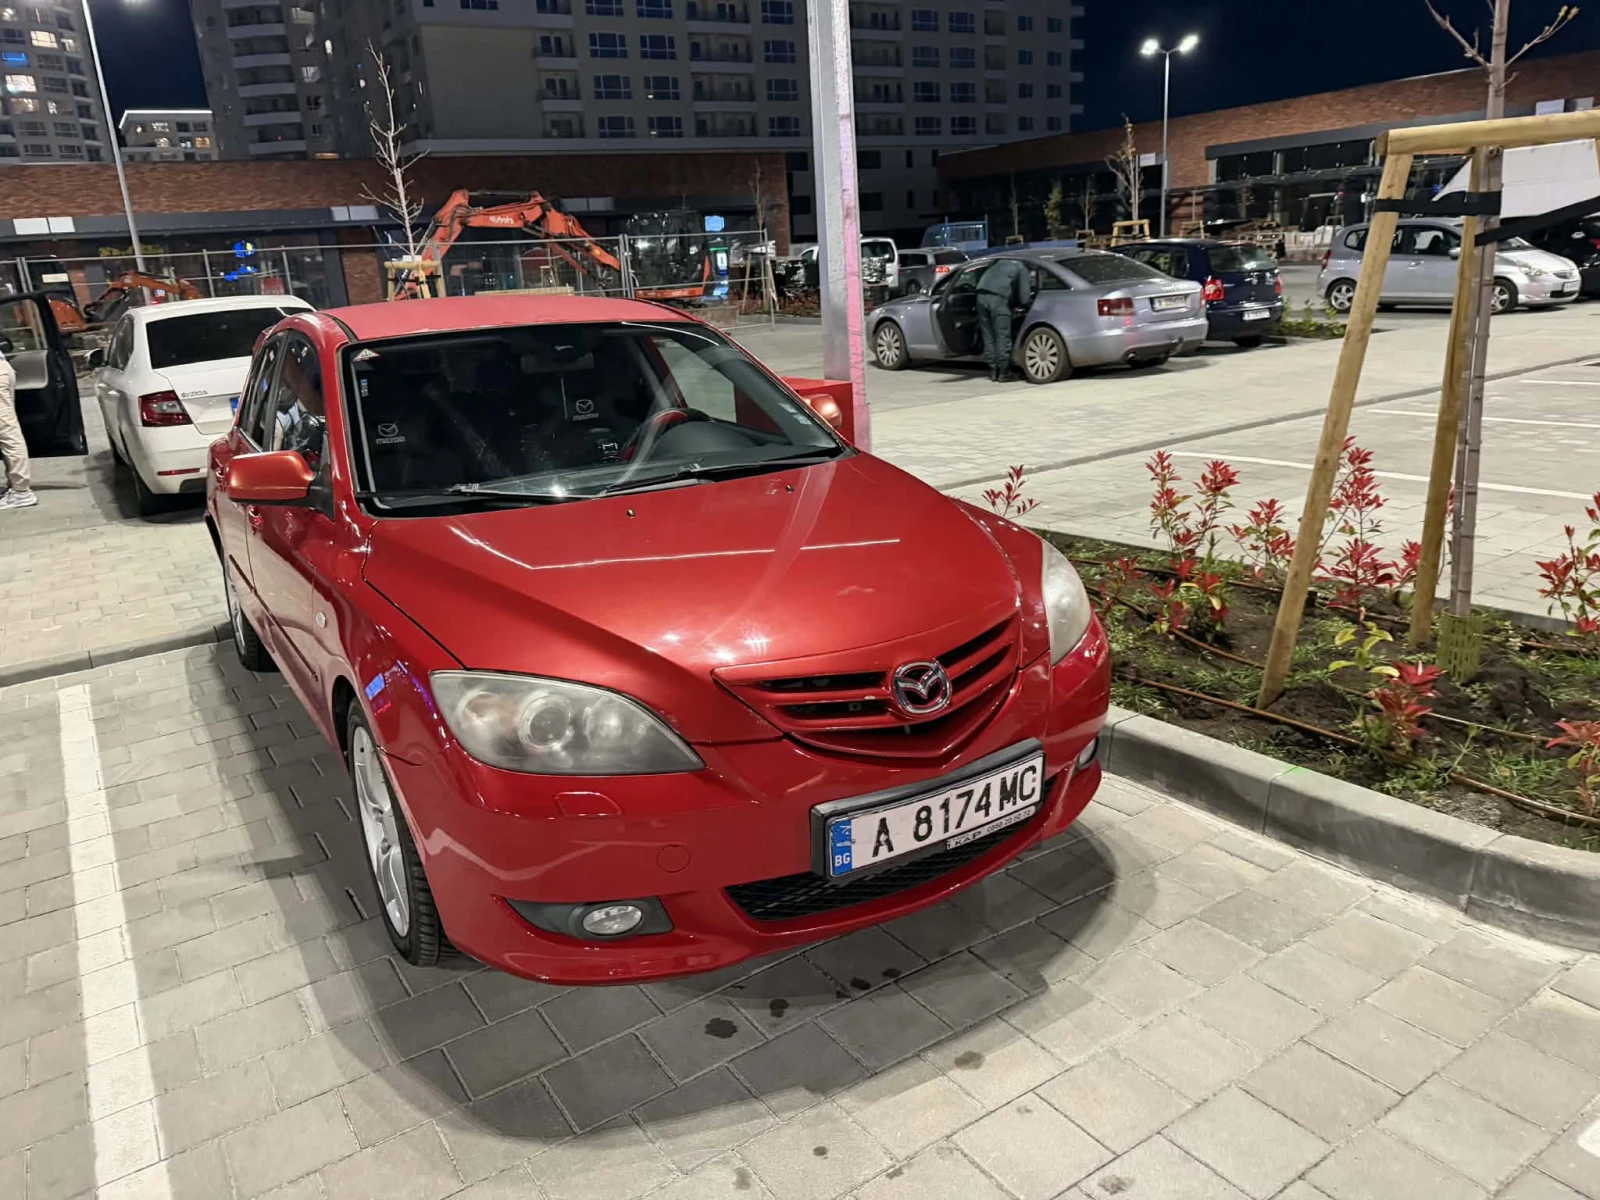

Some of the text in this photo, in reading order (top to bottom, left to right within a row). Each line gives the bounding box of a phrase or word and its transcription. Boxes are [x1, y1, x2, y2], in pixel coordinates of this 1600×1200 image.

[872, 765, 1036, 857] A 8174 MC
[834, 853, 851, 867] BG
